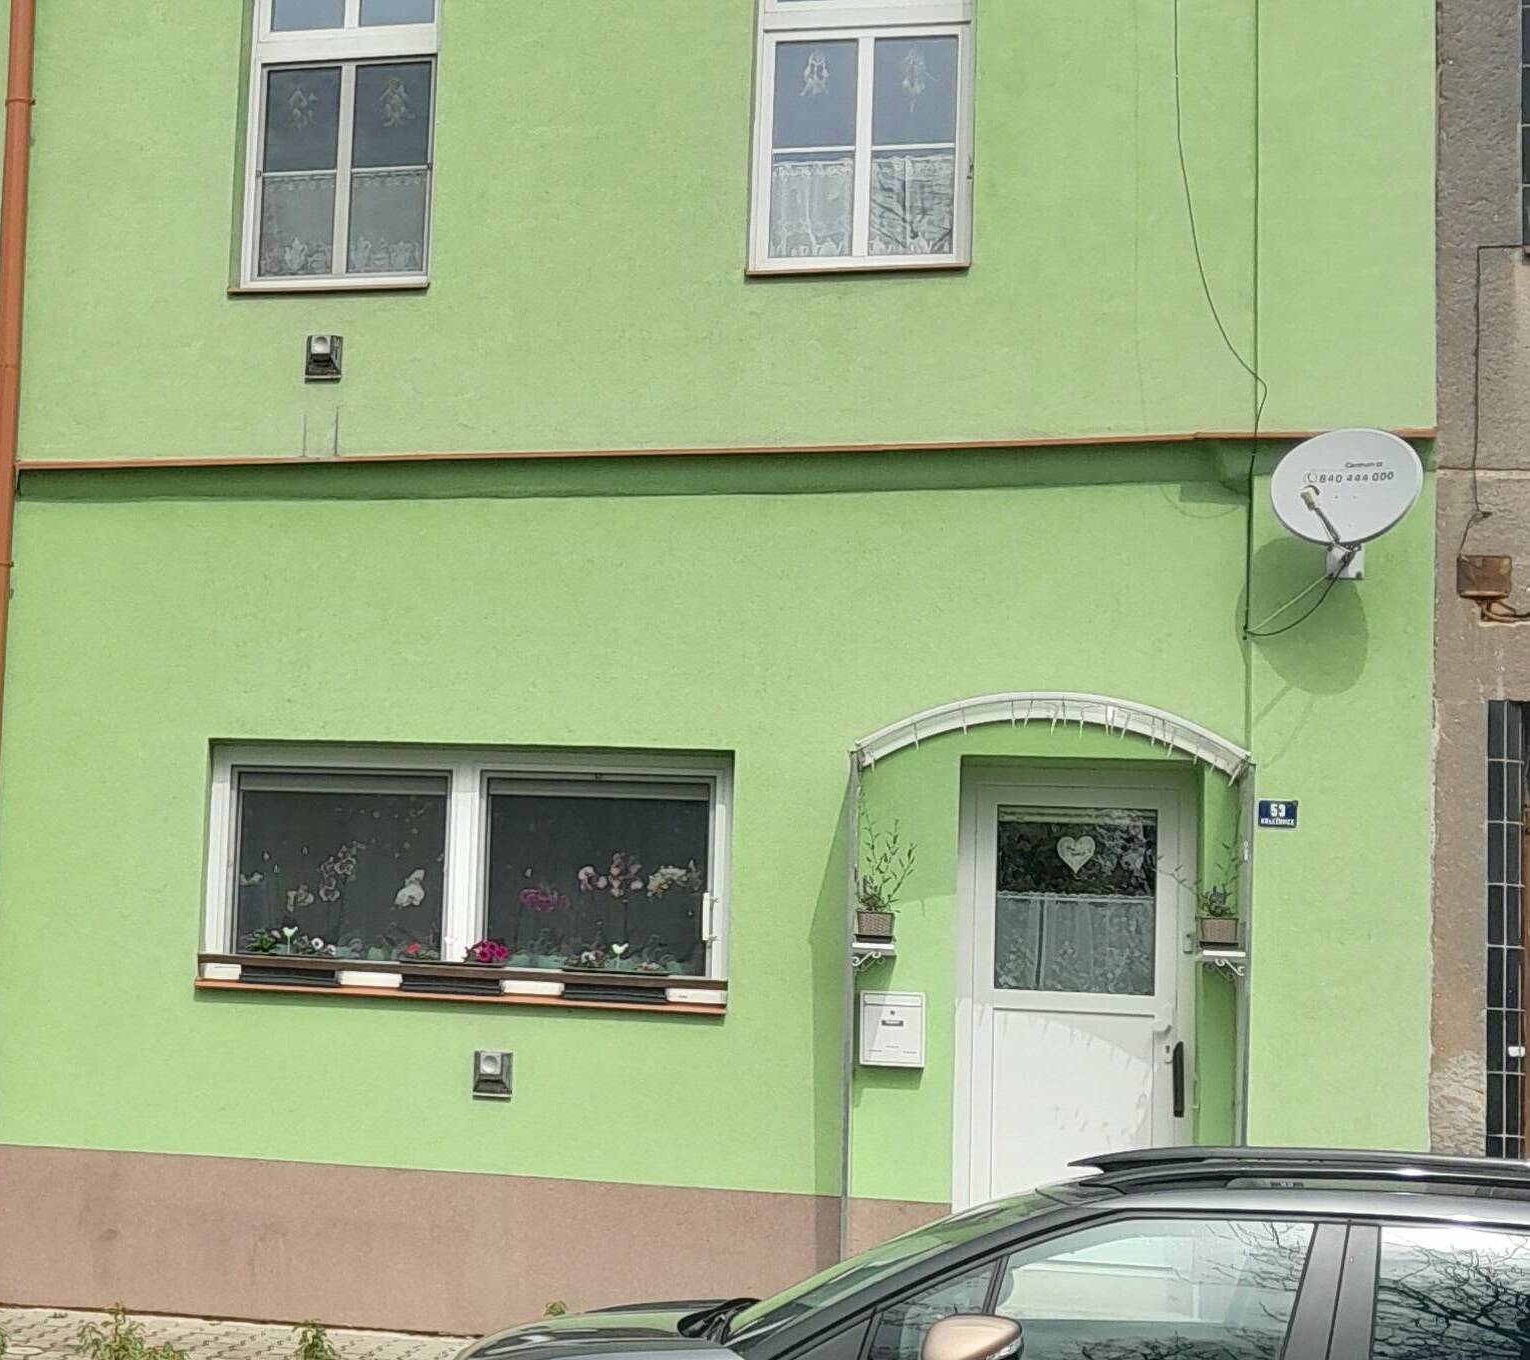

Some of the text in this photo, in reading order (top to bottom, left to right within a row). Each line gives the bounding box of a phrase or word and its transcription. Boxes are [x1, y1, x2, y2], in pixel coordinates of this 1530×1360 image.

[1319, 474, 1342, 483] 840
[1372, 471, 1394, 481] 000
[1270, 803, 1286, 817] 53
